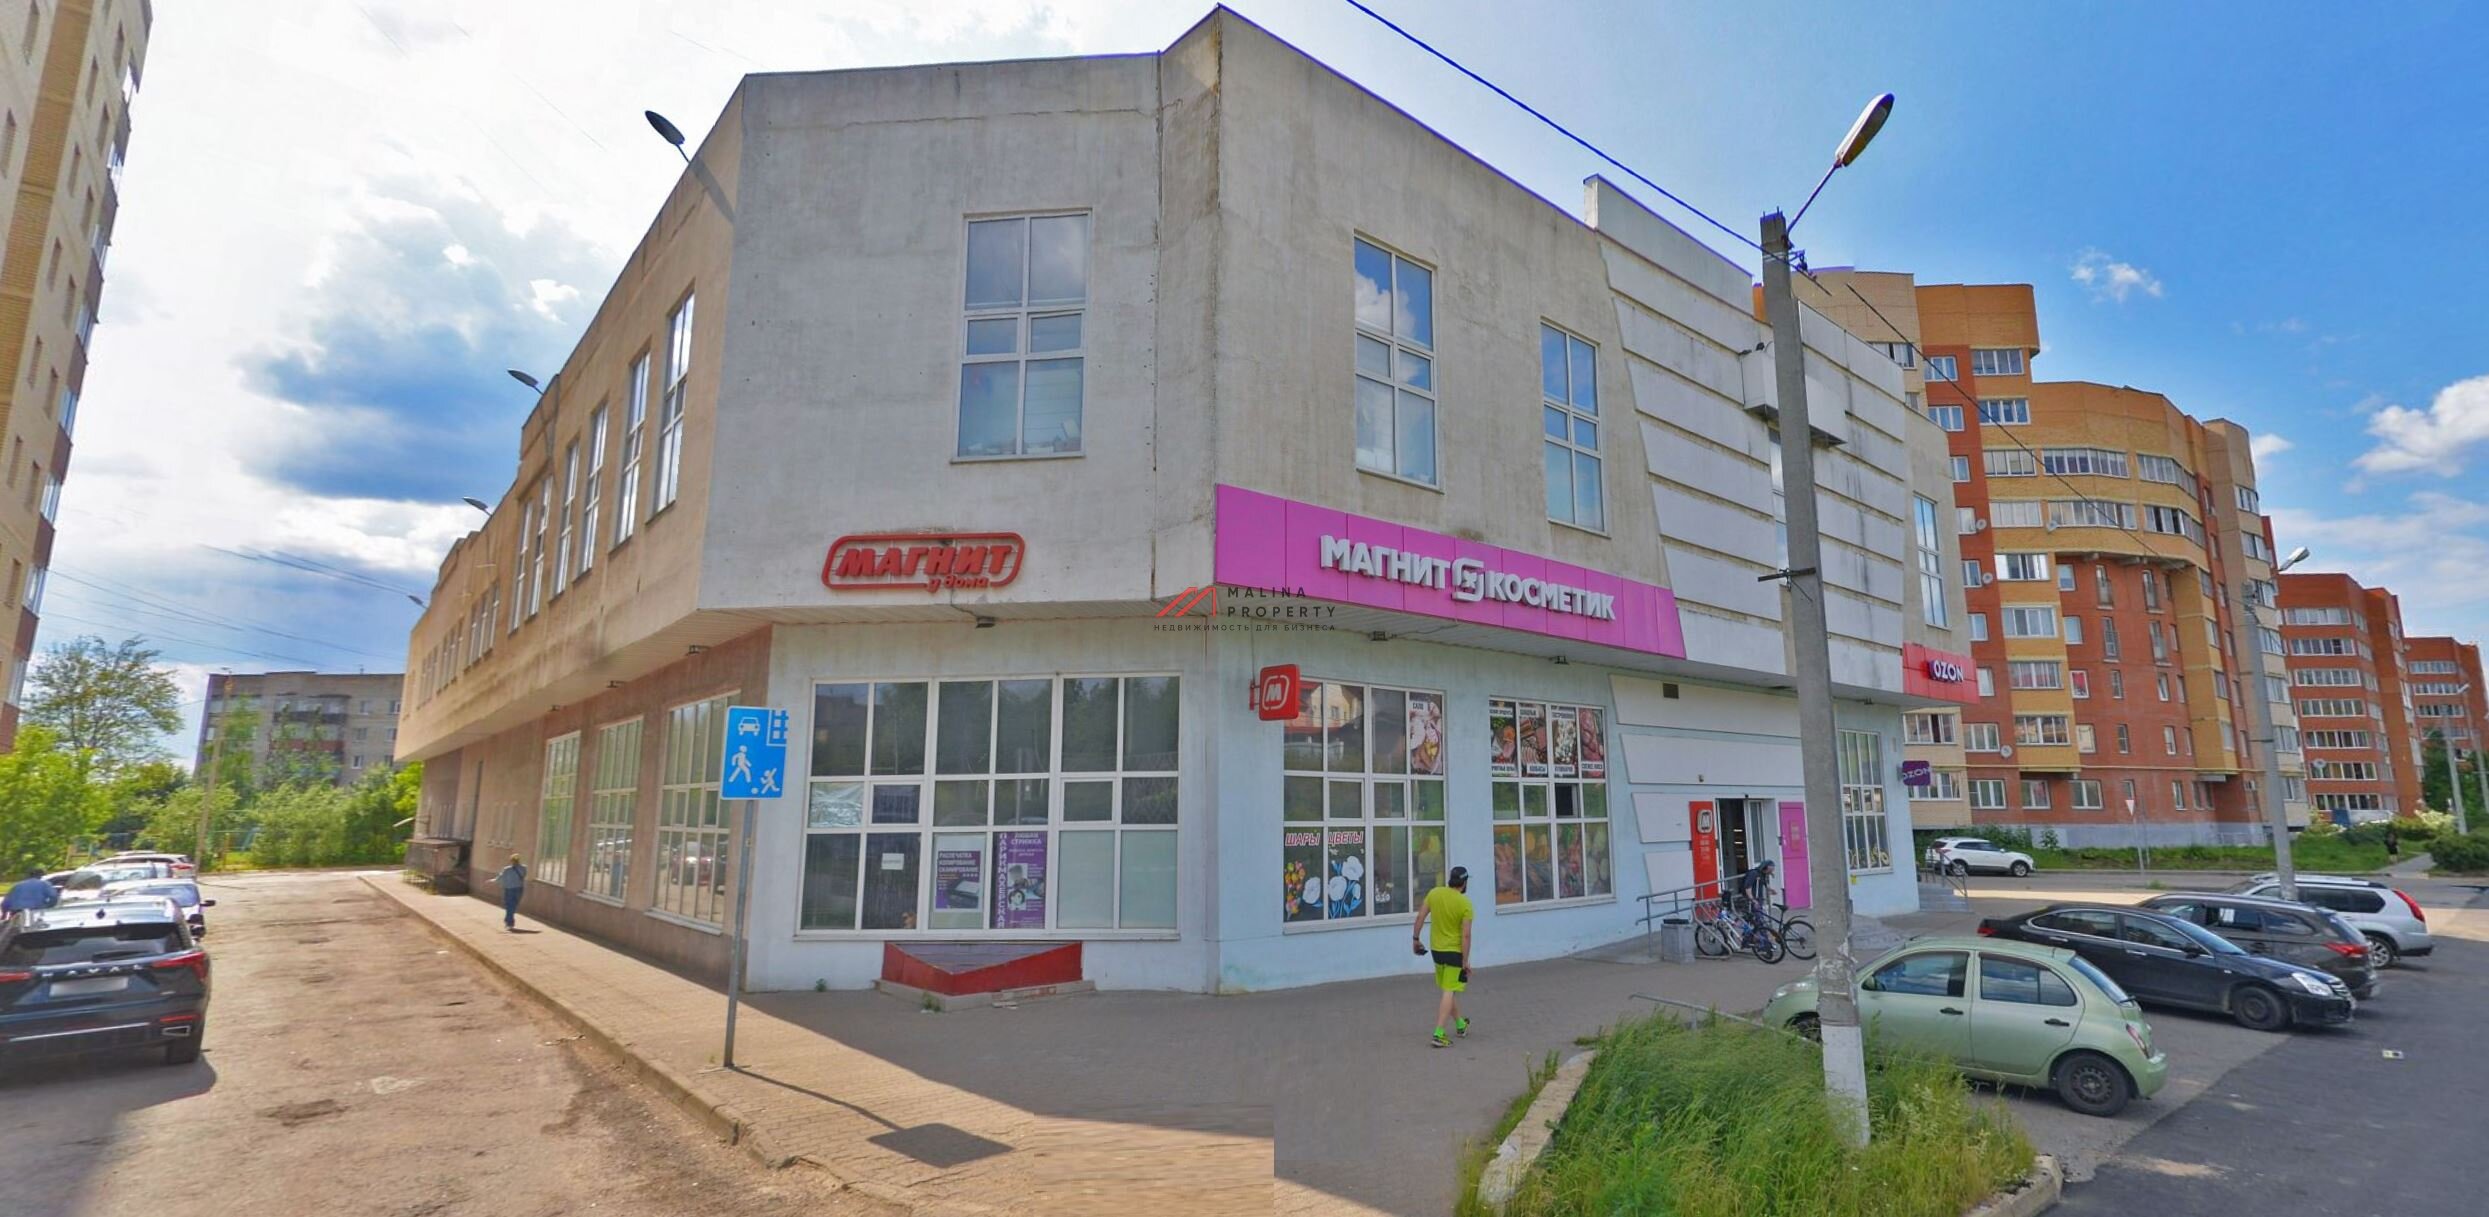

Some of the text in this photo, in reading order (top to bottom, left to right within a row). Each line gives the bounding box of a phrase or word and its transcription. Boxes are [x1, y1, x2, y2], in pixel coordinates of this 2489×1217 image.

[835, 545, 1013, 577] МАГНИТ
[1320, 534, 1616, 621] МАГНИТ КОСМЕТИК
[1932, 660, 1965, 682] OZON
[1285, 832, 1321, 847] ШАРЫ
[1328, 831, 1364, 847] ЦВЕТЫ
